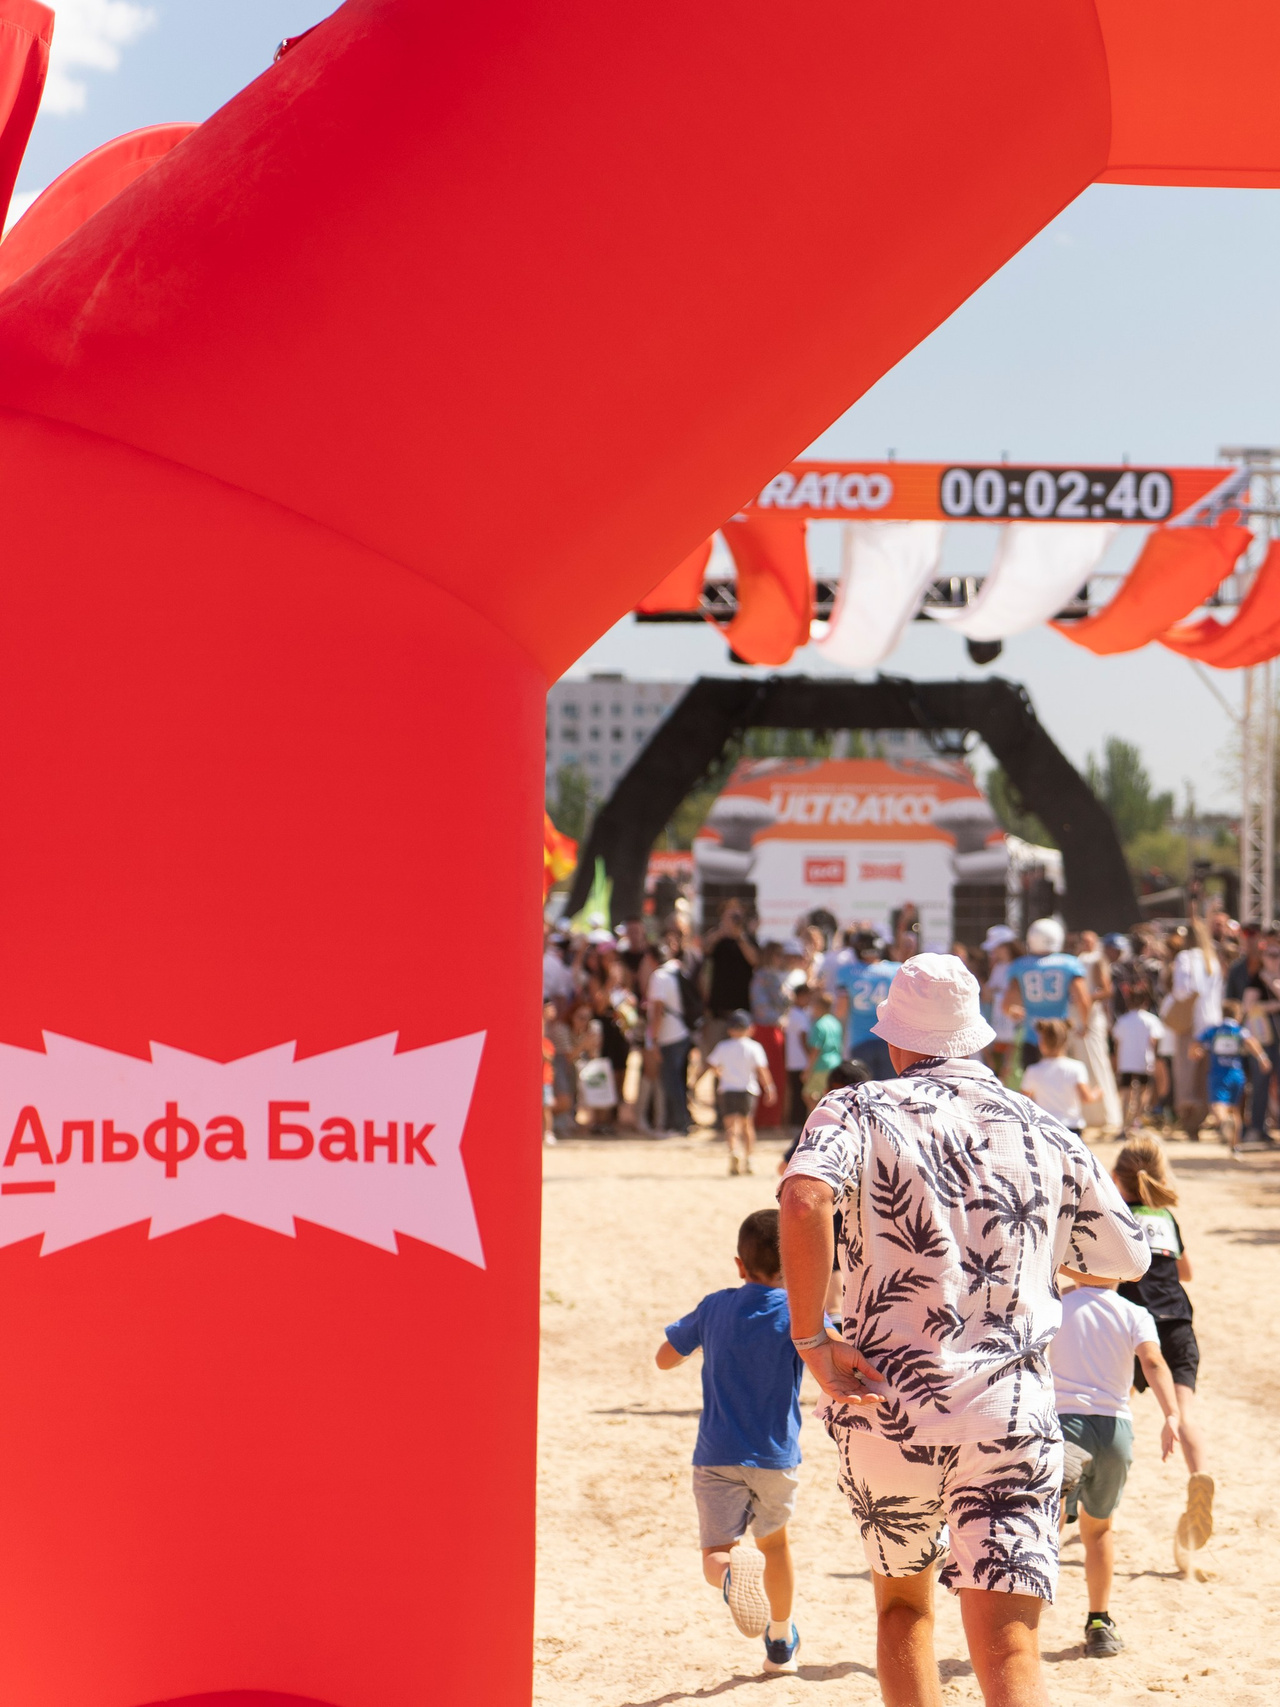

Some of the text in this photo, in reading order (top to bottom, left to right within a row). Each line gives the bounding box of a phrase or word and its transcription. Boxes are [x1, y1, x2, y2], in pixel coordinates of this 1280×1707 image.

[743, 471, 894, 511] RA100
[941, 468, 1171, 519] 00:02:40
[771, 791, 937, 825] ULTRA100
[853, 979, 889, 1010] 24
[1022, 969, 1065, 1002] 83
[3, 1101, 437, 1180] Альфа Банк
